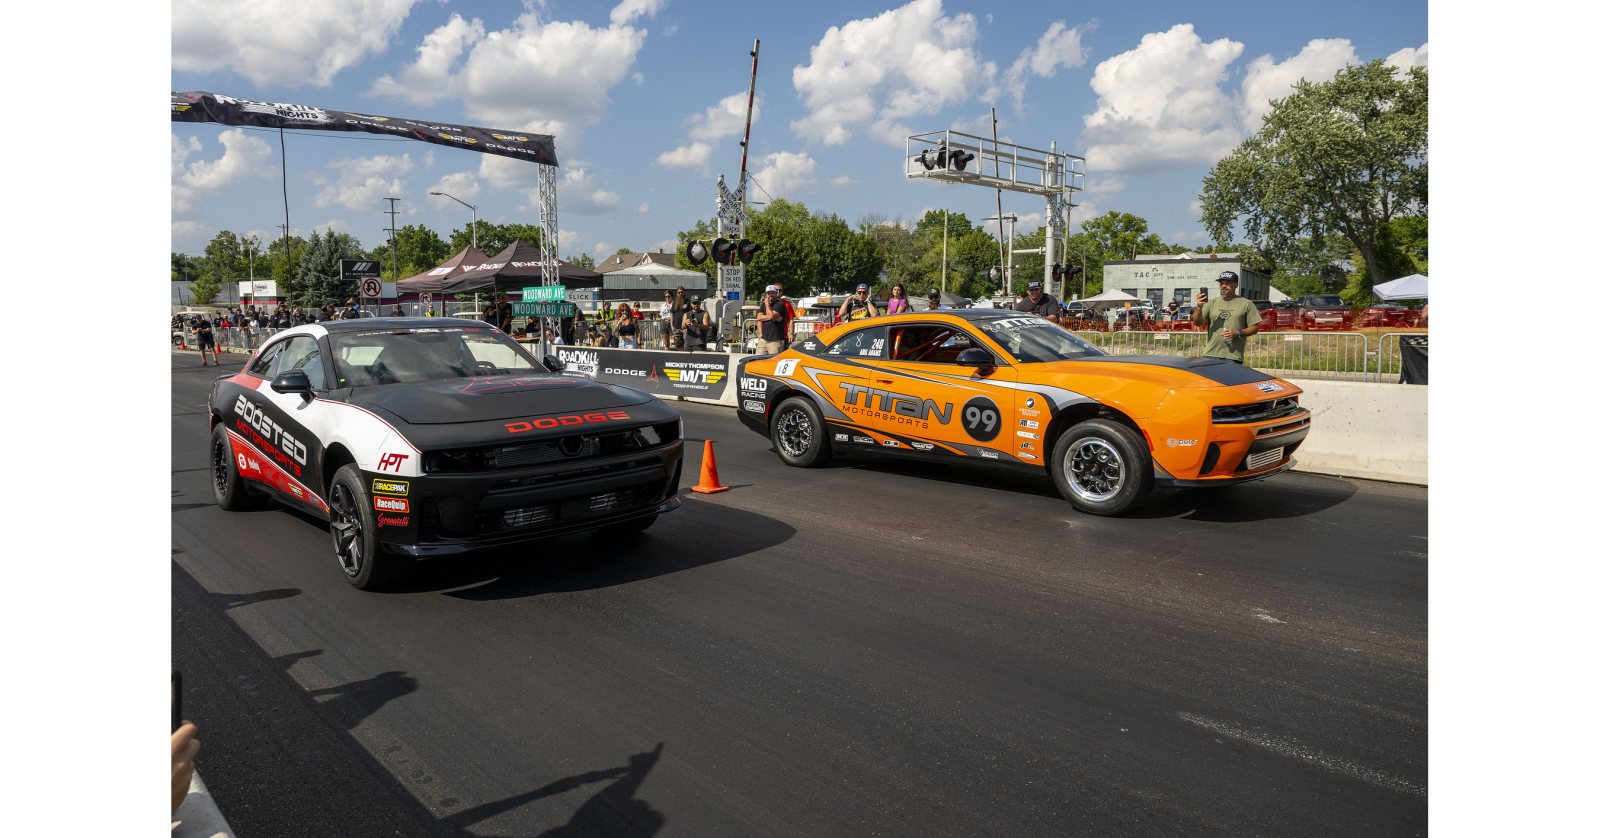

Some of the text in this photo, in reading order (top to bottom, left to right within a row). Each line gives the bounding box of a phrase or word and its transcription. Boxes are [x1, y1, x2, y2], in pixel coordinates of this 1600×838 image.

[275, 108, 317, 119] NIGHTS
[523, 288, 565, 300] WOODWARD AVE
[514, 303, 573, 316] WOODWARD AVE
[856, 332, 864, 347] 8
[872, 338, 884, 350] 240
[559, 350, 599, 364] ROADKILL
[578, 364, 594, 372] NIGHTS
[605, 368, 646, 376] DODGE
[680, 369, 710, 383] M/T
[740, 377, 767, 392] WELD
[504, 411, 630, 433] DODGE
[842, 406, 928, 429] MOTORSPORTS
[966, 406, 996, 432] 99
[234, 394, 306, 466] BOOSTED
[236, 418, 302, 476] MOTORSPORTS
[377, 452, 409, 472] HPT
[380, 482, 406, 492] RACEPAK
[377, 499, 406, 510] RaceQuip
